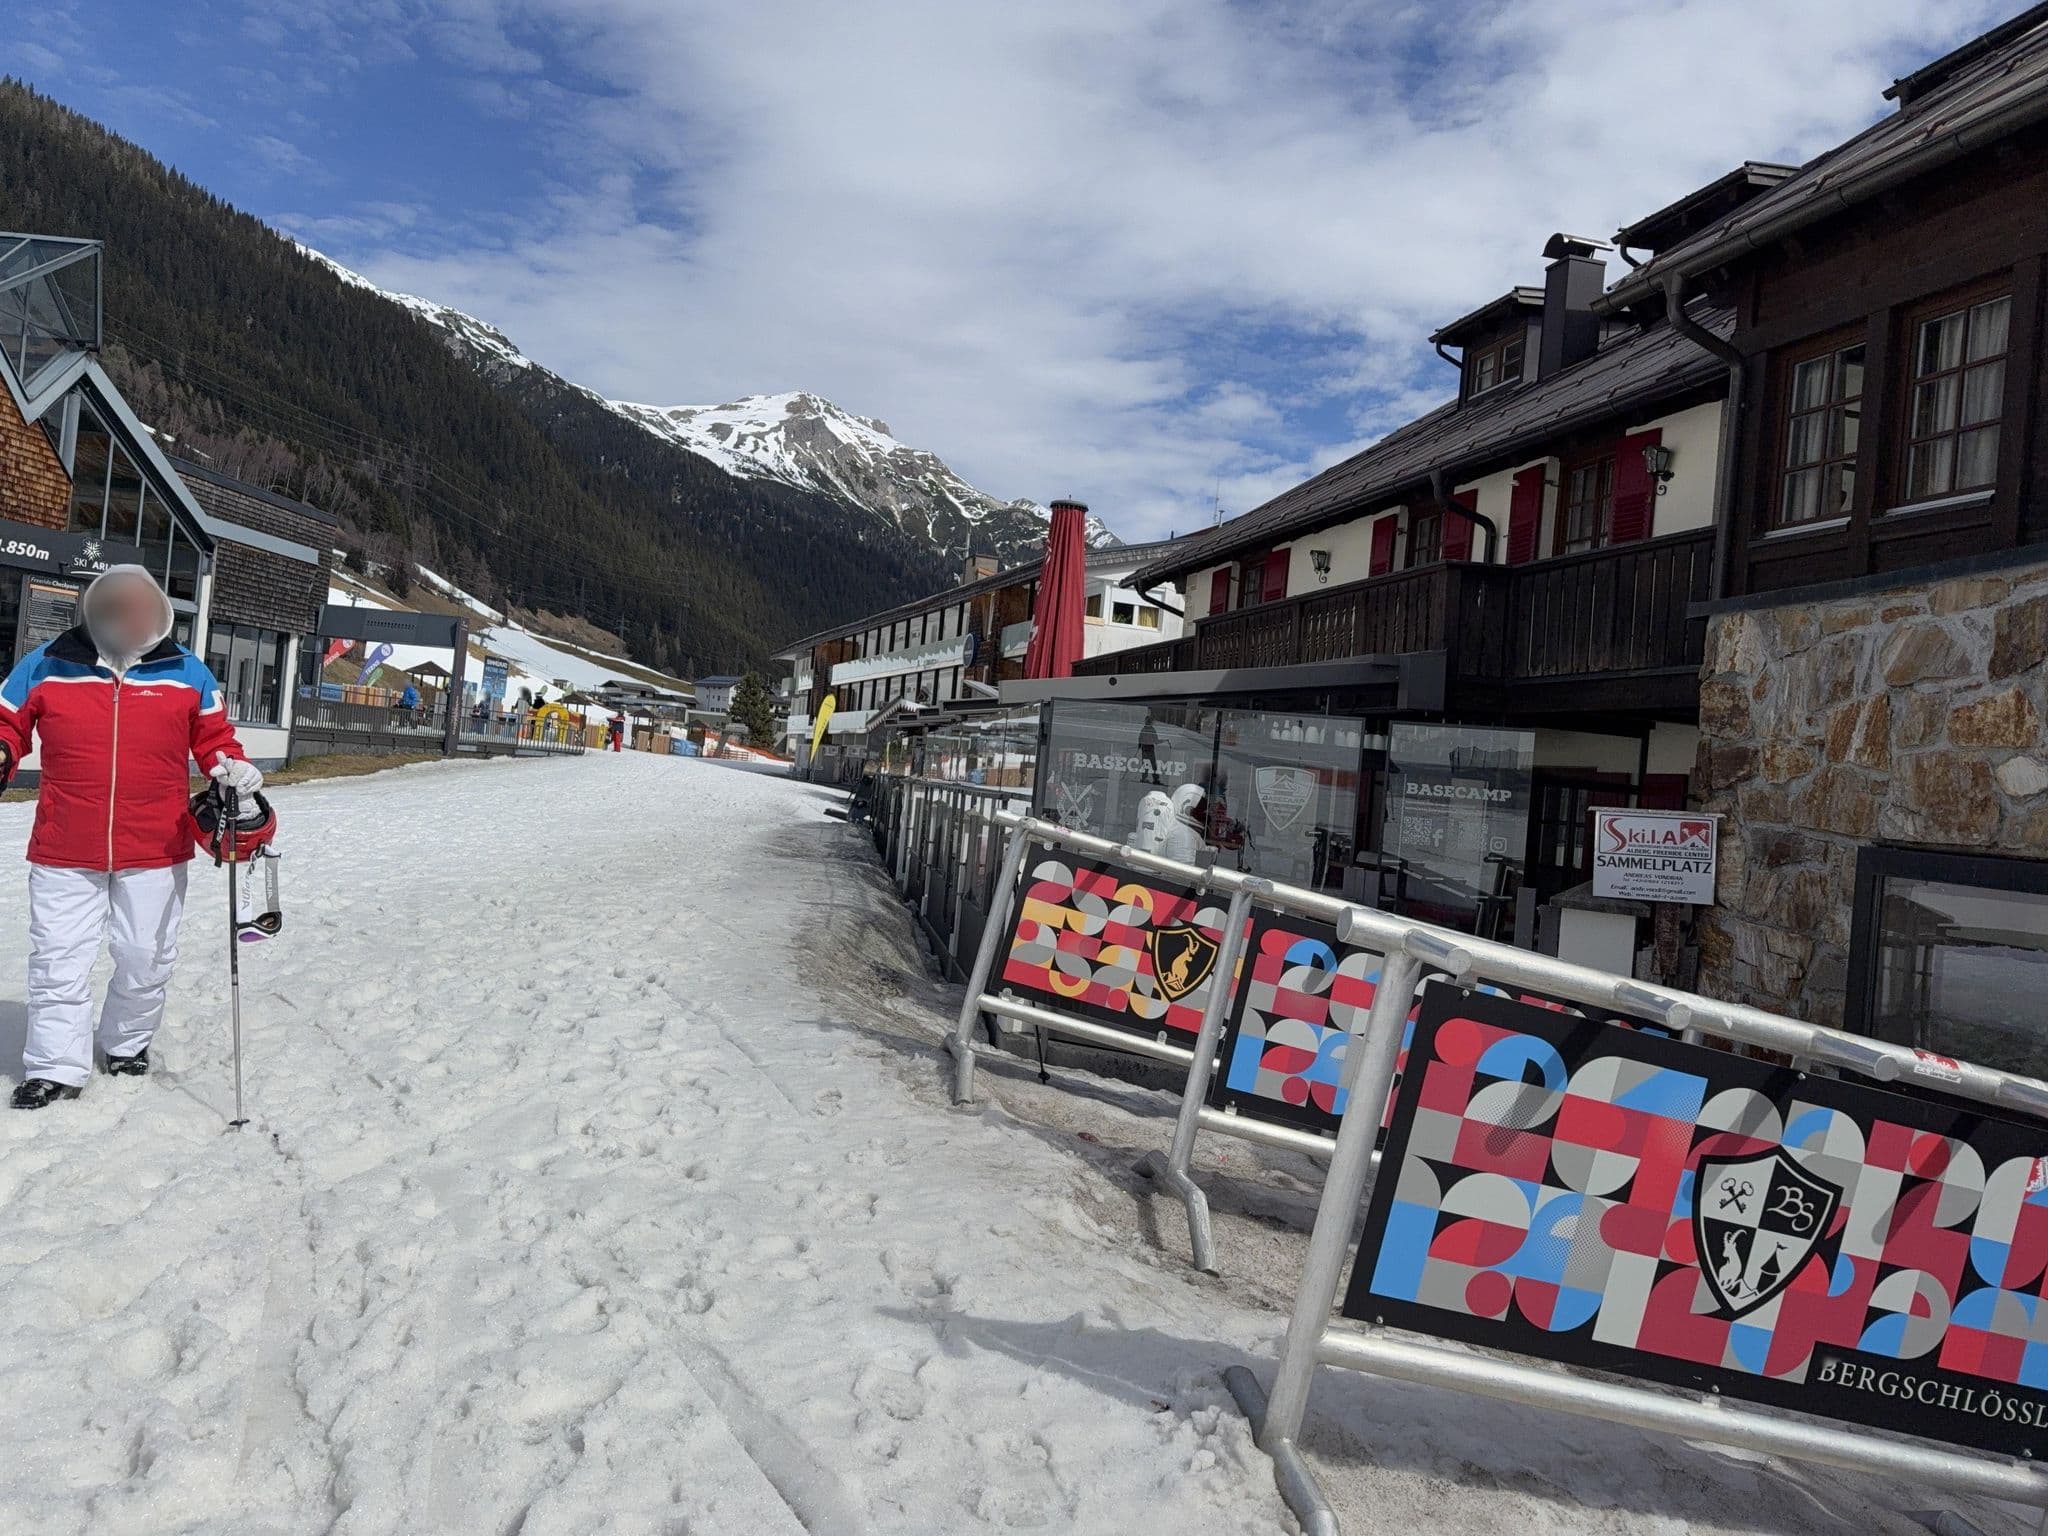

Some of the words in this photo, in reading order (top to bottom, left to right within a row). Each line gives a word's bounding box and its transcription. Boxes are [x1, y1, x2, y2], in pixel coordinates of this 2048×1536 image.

[0, 538, 49, 561] .850m
[73, 557, 88, 568] SKI
[1073, 752, 1187, 776] BASECAMP
[1406, 782, 1512, 802] BASECAMP
[1597, 855, 1712, 874] SAMMELPLATZ
